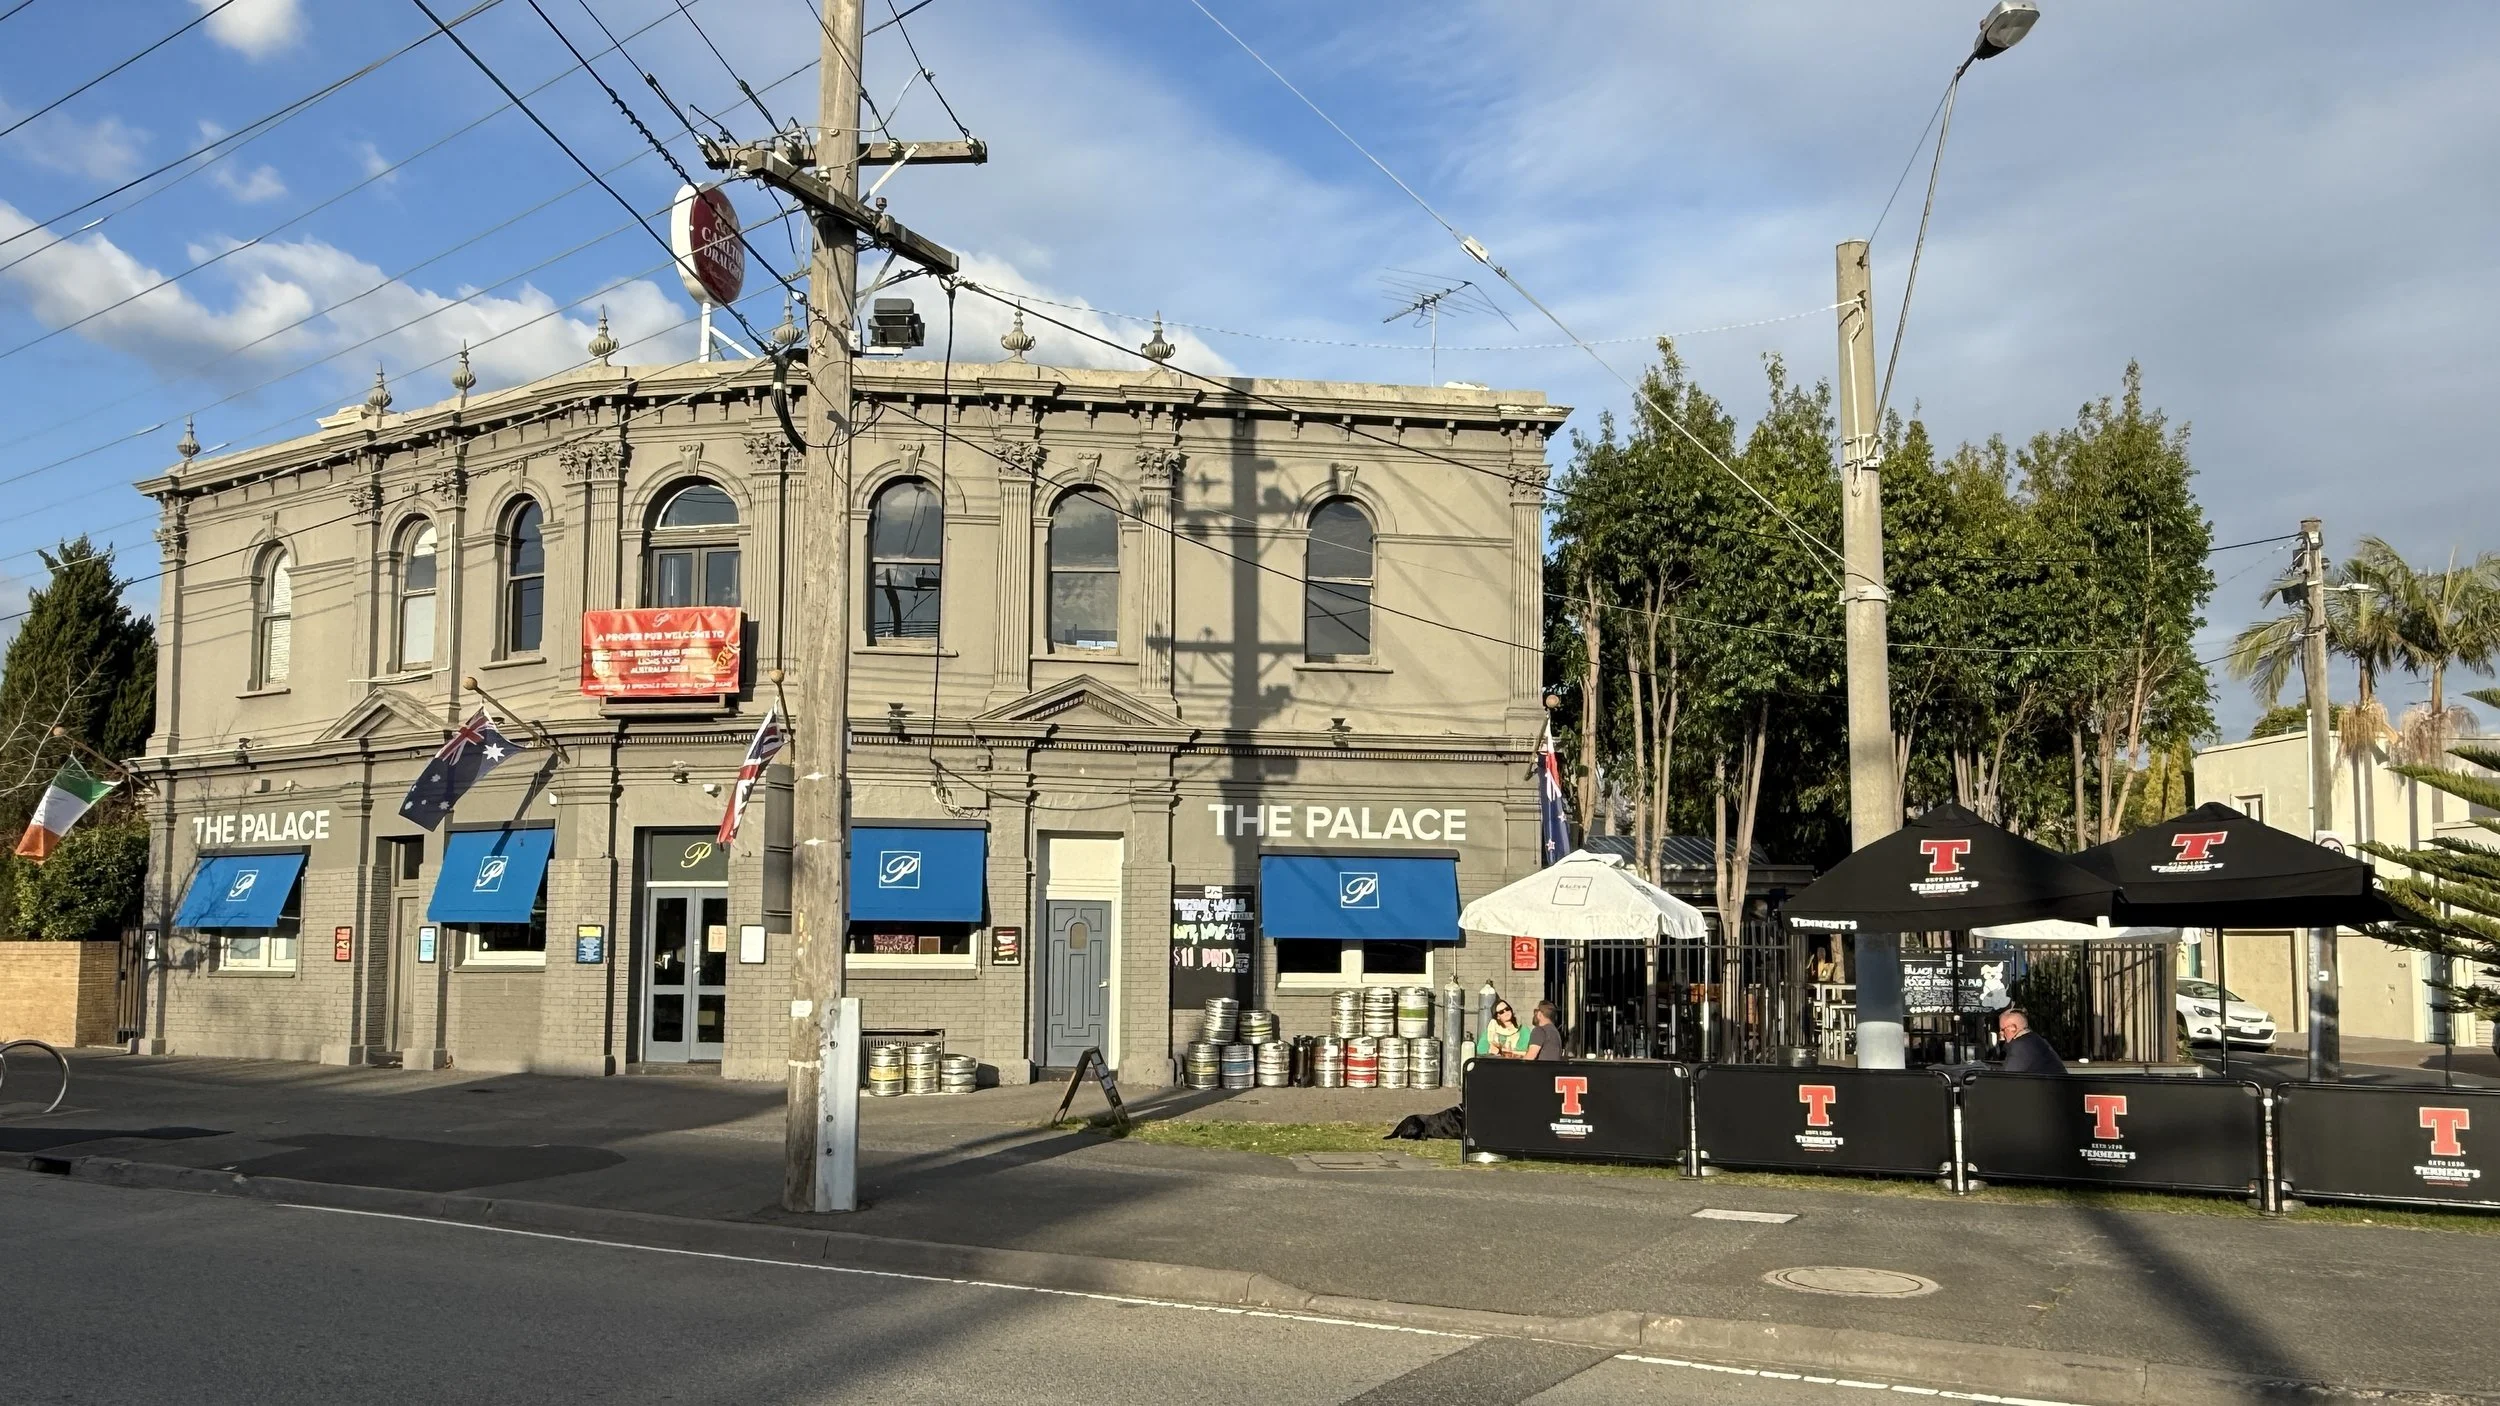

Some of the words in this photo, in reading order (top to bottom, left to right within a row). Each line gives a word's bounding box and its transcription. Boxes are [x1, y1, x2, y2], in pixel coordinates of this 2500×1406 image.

[606, 632, 643, 641] PROPER
[644, 632, 662, 640] PUB
[664, 631, 711, 640] WELCOME
[712, 630, 725, 639] TO
[193, 815, 236, 844] THE
[241, 810, 330, 843] PALACE
[1208, 804, 1292, 837] THE
[1306, 806, 1467, 841] PALACE
[1920, 839, 1971, 874] T
[2171, 831, 2228, 861] T
[881, 855, 920, 883] P
[1341, 877, 1377, 904] P
[1790, 917, 1858, 931] TENNENT'S
[1936, 967, 1964, 975] HOTL
[1555, 1076, 1587, 1115] T
[1799, 1084, 1836, 1126] T
[2084, 1094, 2128, 1139] T
[2419, 1106, 2470, 1156] T
[2079, 1149, 2136, 1160] TENNENT'S
[2413, 1165, 2481, 1179] TENNENT'S
